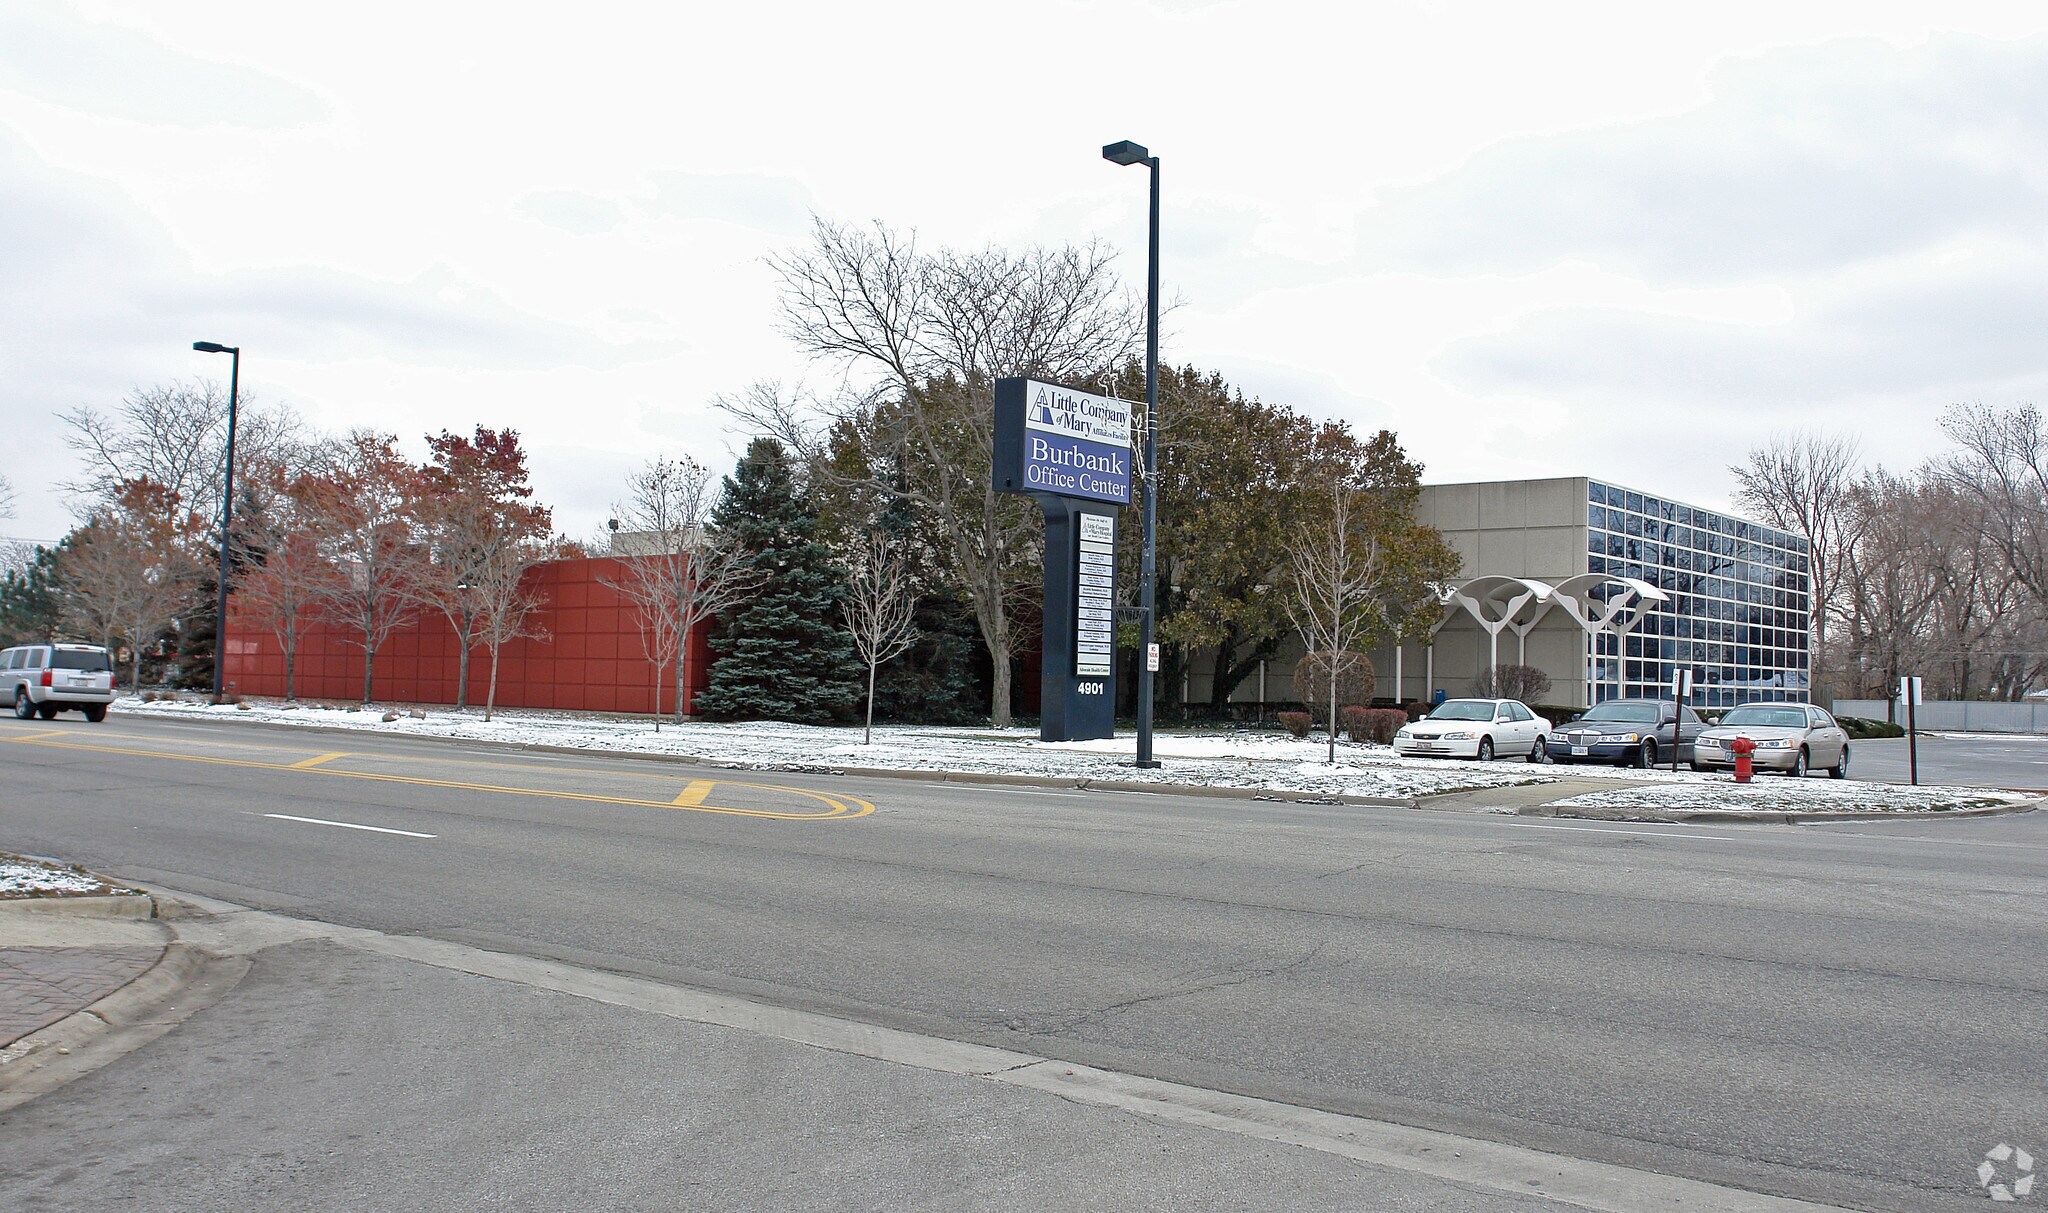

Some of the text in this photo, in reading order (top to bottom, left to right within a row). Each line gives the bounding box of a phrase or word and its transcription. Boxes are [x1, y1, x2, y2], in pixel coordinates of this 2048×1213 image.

[1051, 391, 1128, 428] Little Company
[1056, 412, 1093, 437] of Mary
[1031, 437, 1125, 475] Burbank
[1028, 464, 1127, 497] Office Center
[1077, 682, 1104, 695] 4901
